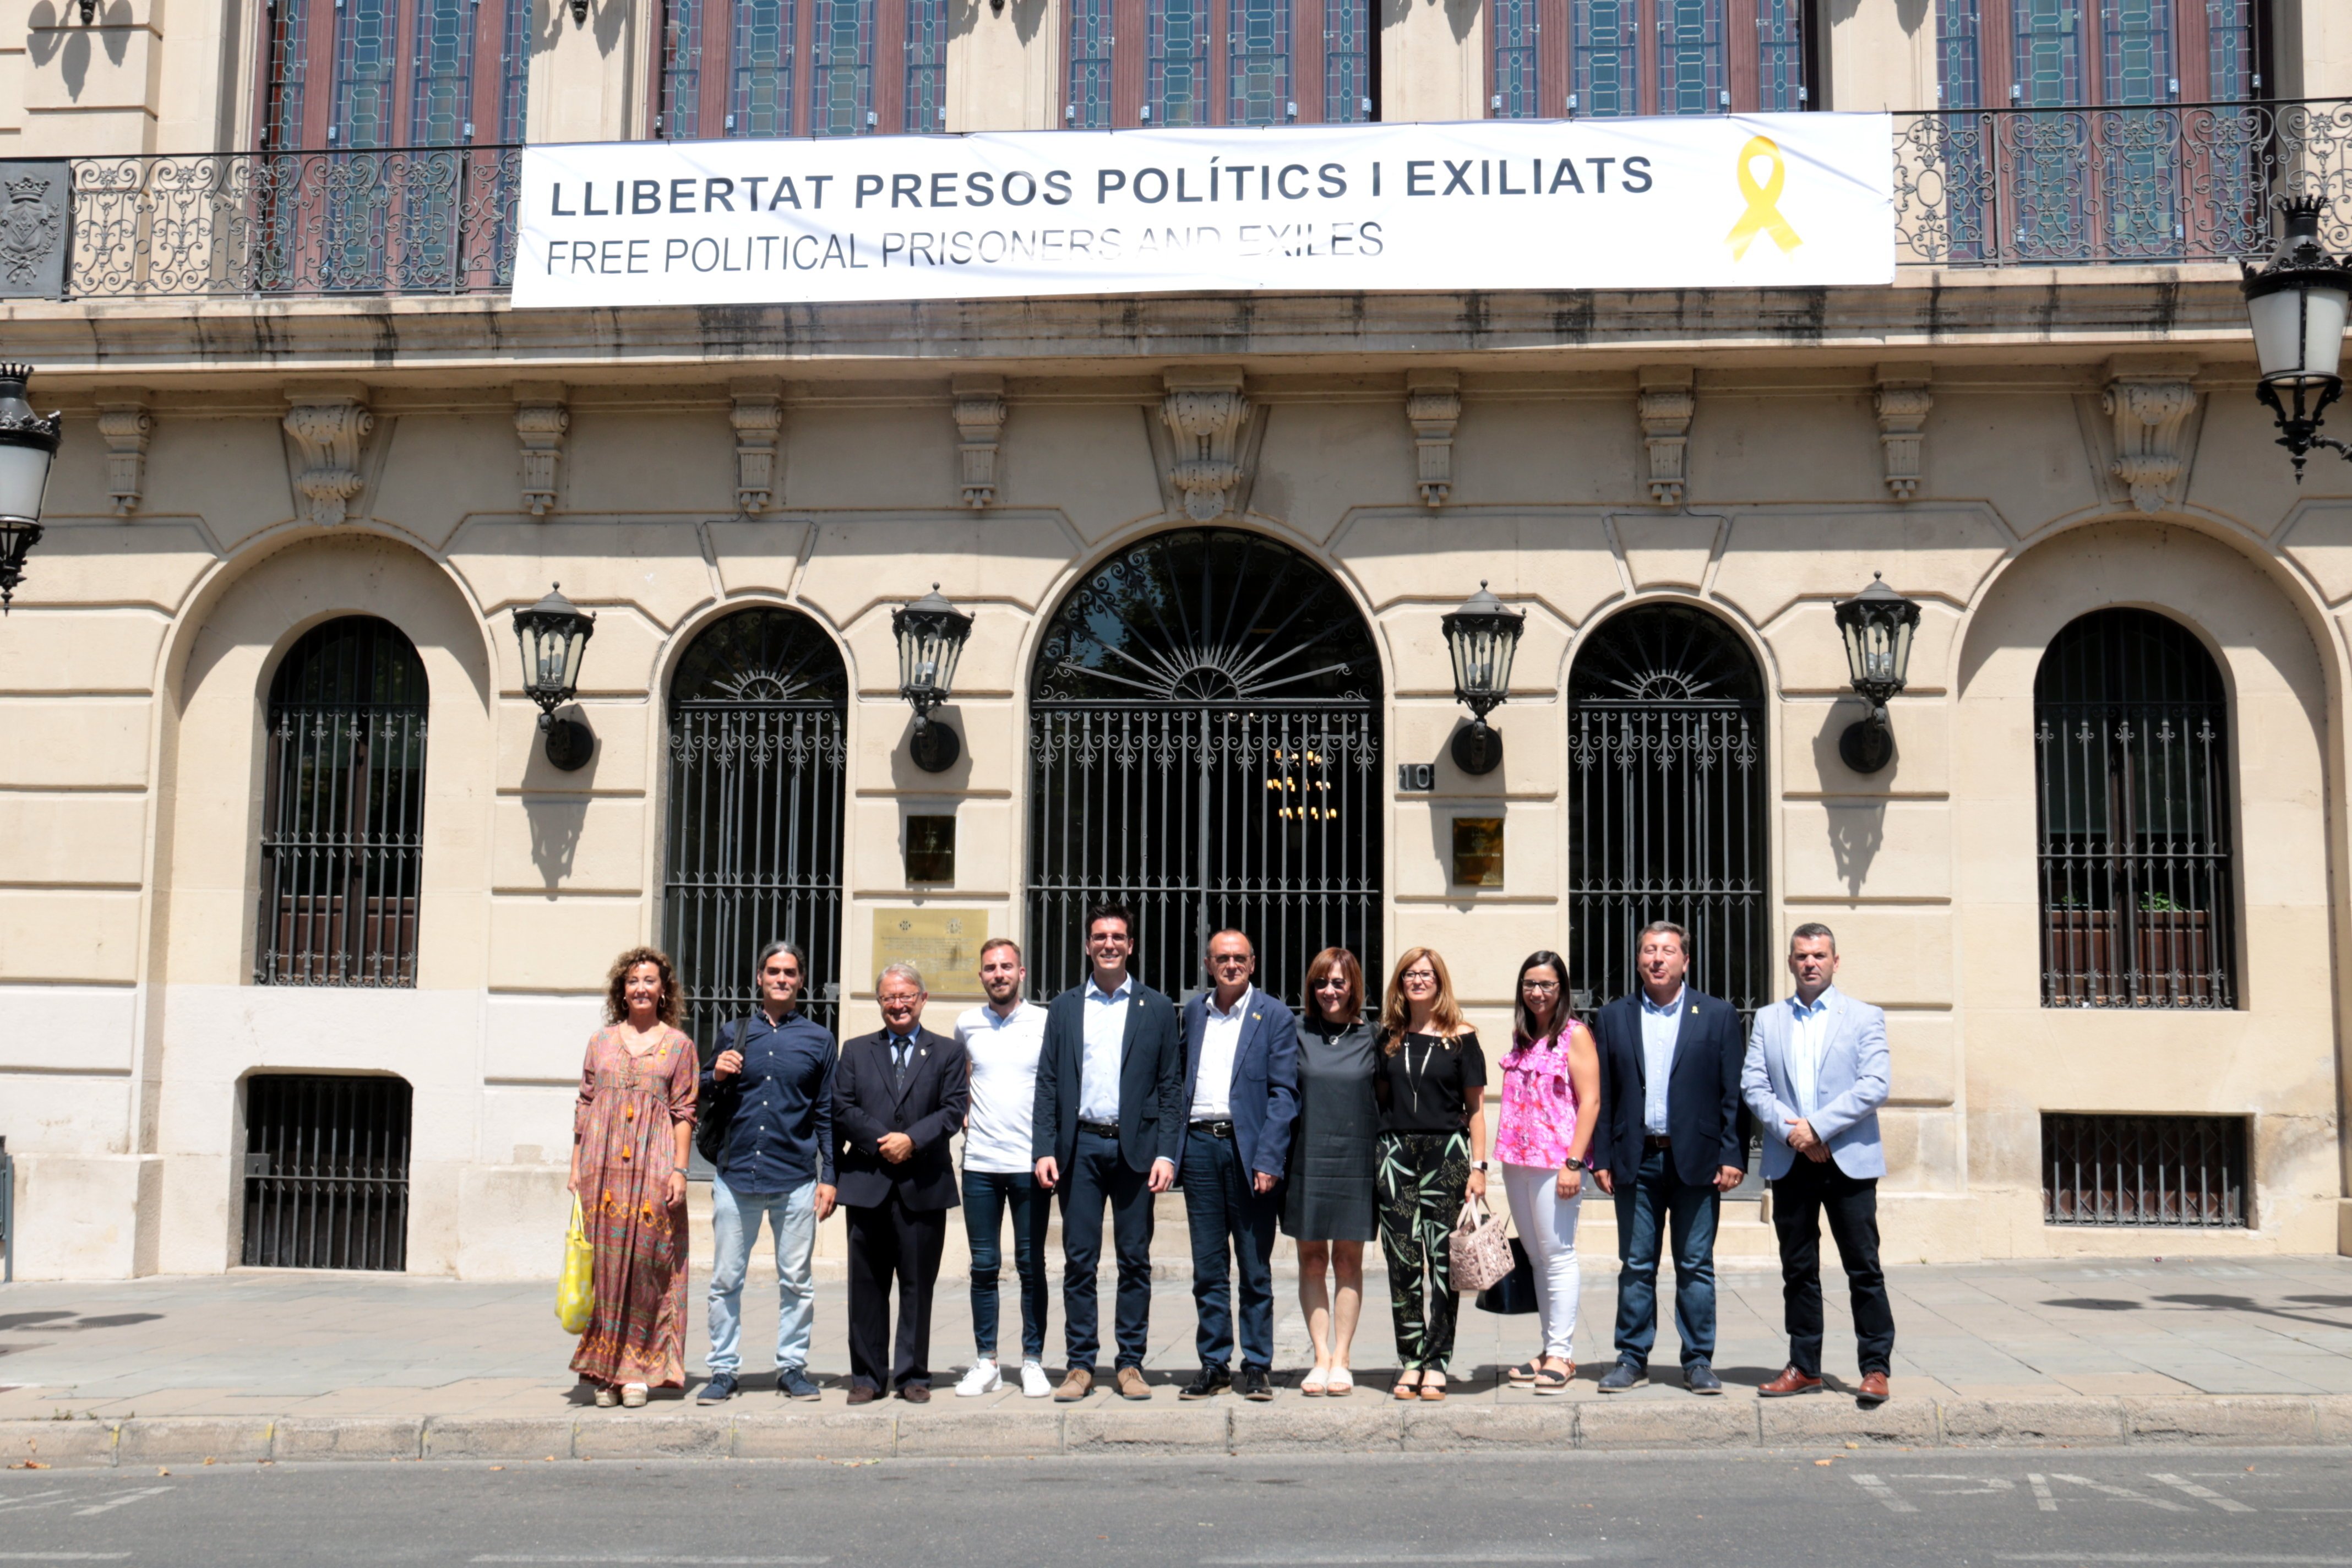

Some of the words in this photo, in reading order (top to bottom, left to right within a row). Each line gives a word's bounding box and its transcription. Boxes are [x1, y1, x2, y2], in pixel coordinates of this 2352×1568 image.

[552, 176, 833, 215] LLIBERTAT
[856, 171, 1071, 208] PRESOS
[1098, 156, 1347, 203] POLÍTICS
[1373, 162, 1380, 196] I
[1408, 156, 1652, 195] EXILIATS
[548, 240, 649, 275] FREE
[666, 233, 868, 272] POLITICAL
[883, 228, 1121, 267] PRISONERS
[1240, 221, 1383, 257] EXILES
[1402, 765, 1430, 790] 10
